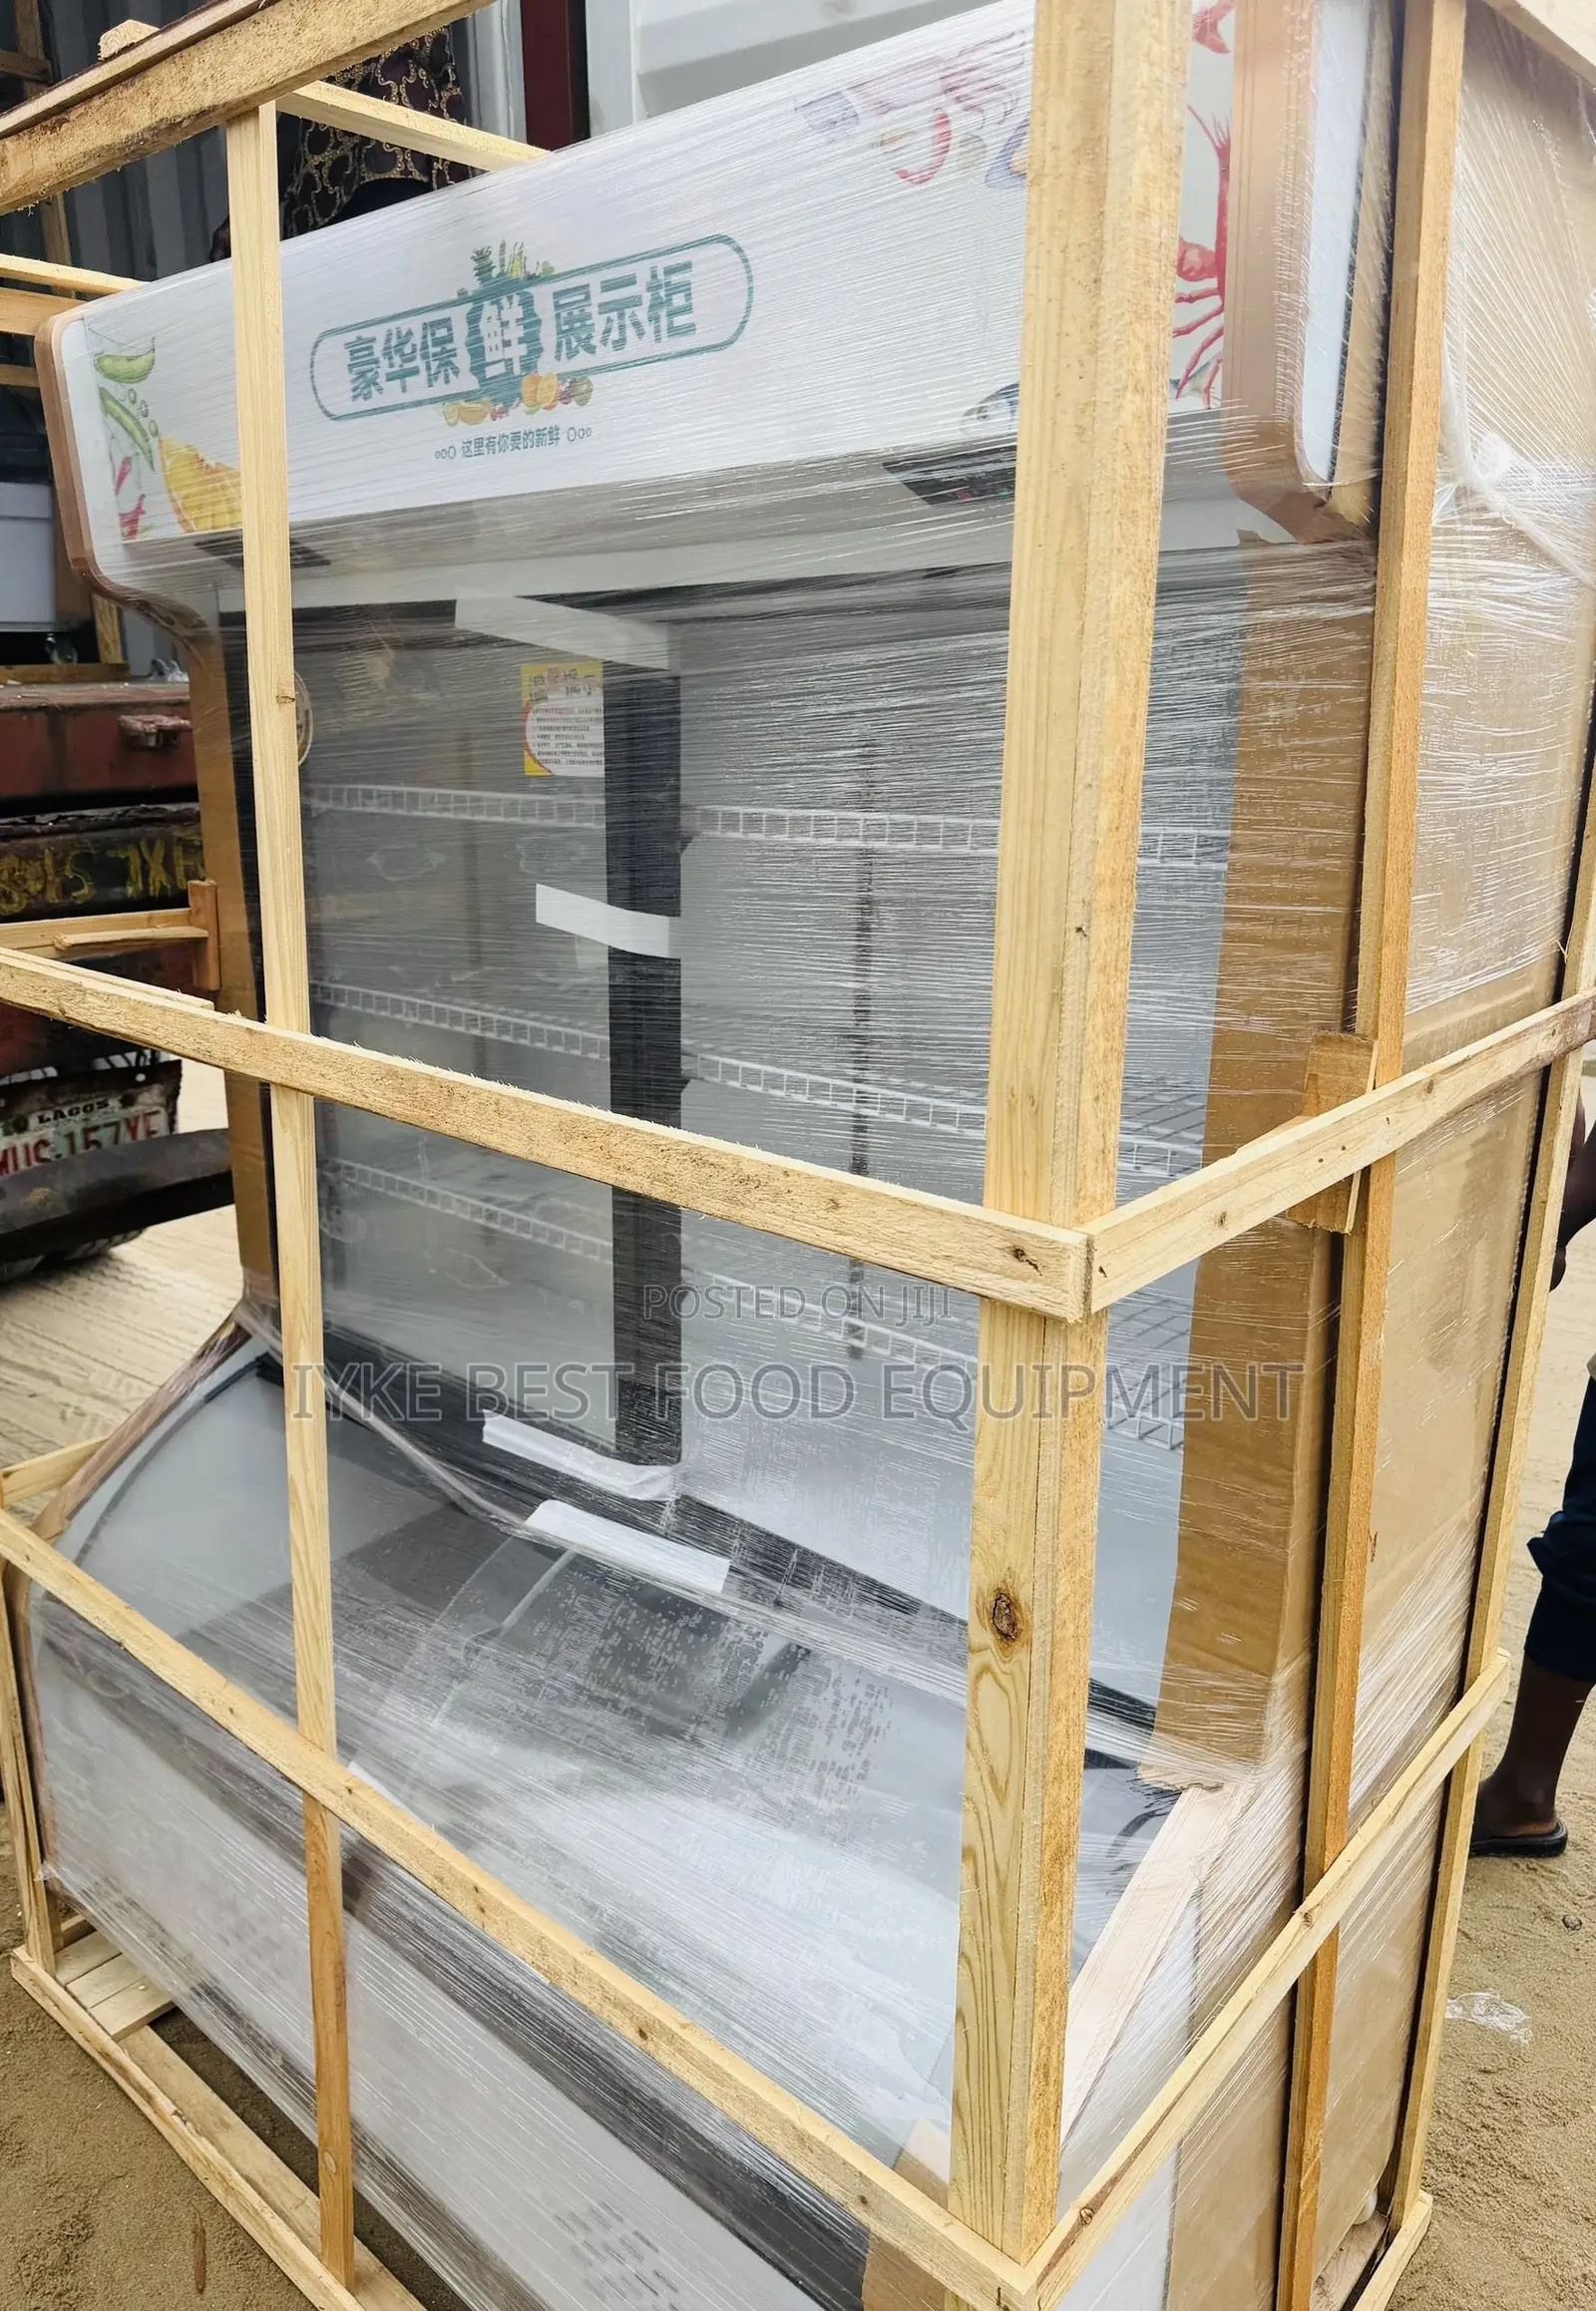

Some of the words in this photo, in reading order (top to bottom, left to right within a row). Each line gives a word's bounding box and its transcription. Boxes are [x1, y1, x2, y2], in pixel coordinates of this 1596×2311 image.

[343, 259, 697, 403] 豪华保鲜展示柜
[461, 424, 562, 460] 这里有你要的新鲜
[37, 1097, 110, 1125] LAGOS
